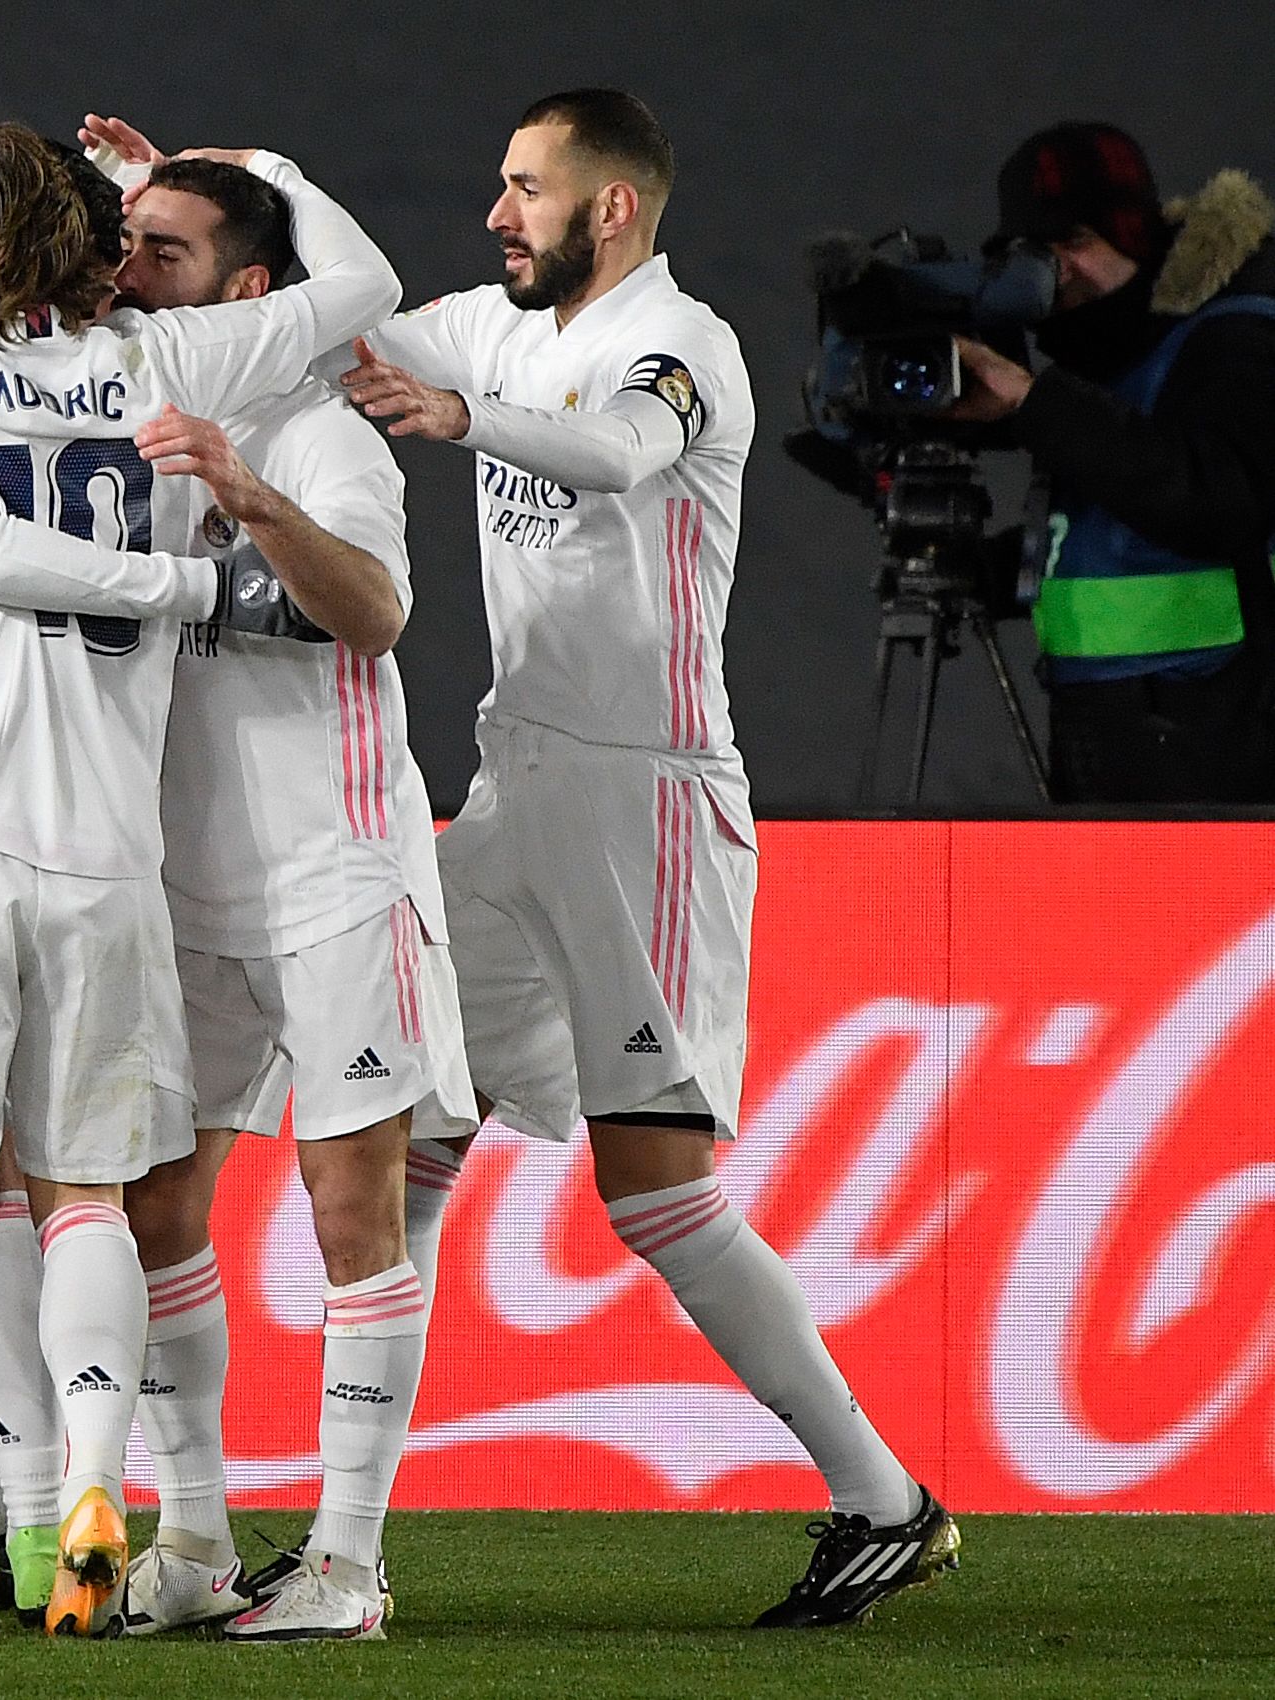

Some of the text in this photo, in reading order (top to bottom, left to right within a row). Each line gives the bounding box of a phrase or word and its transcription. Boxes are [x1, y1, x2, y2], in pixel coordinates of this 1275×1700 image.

[177, 621, 220, 658] TER
[623, 1041, 663, 1054] adidas
[344, 1066, 391, 1080] adidas
[66, 1381, 121, 1396] adidas
[336, 1382, 382, 1396] REAL
[325, 1388, 394, 1404] MADRID
